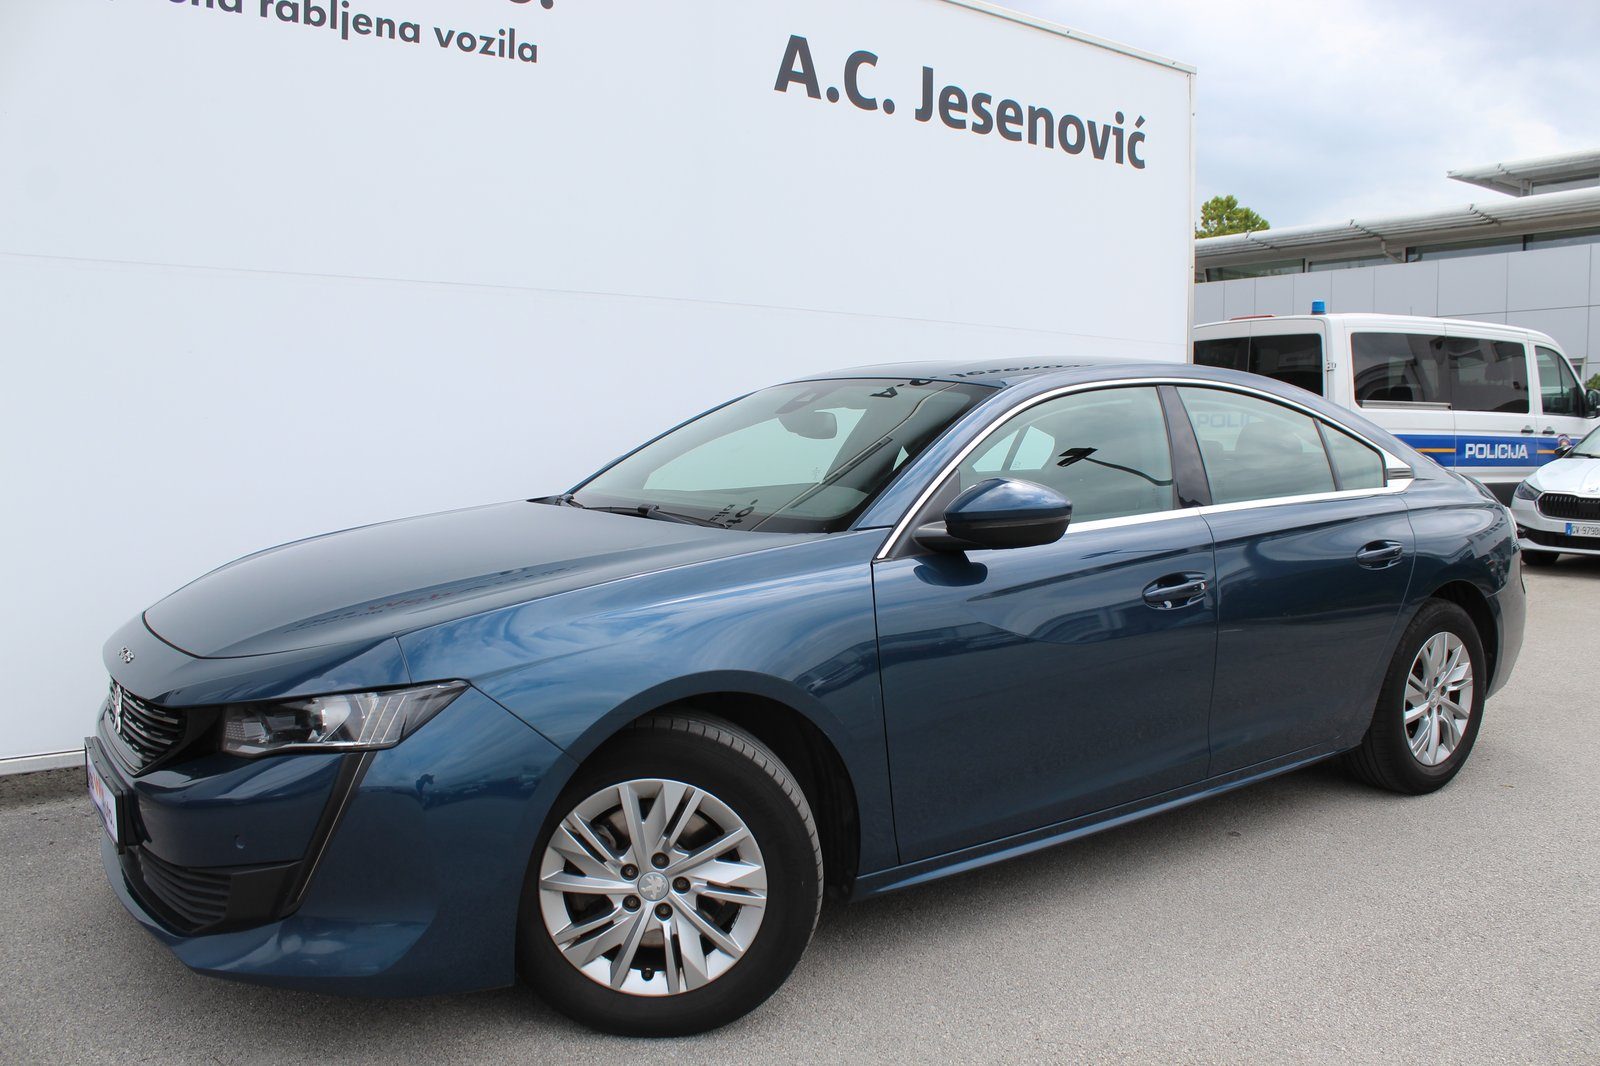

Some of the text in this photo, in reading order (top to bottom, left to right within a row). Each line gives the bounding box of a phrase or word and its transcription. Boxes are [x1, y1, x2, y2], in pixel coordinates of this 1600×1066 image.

[260, 0, 537, 63] rabljena vozila
[774, 35, 1146, 170] A.C. Jesenović
[1465, 443, 1529, 459] POLICIJA
